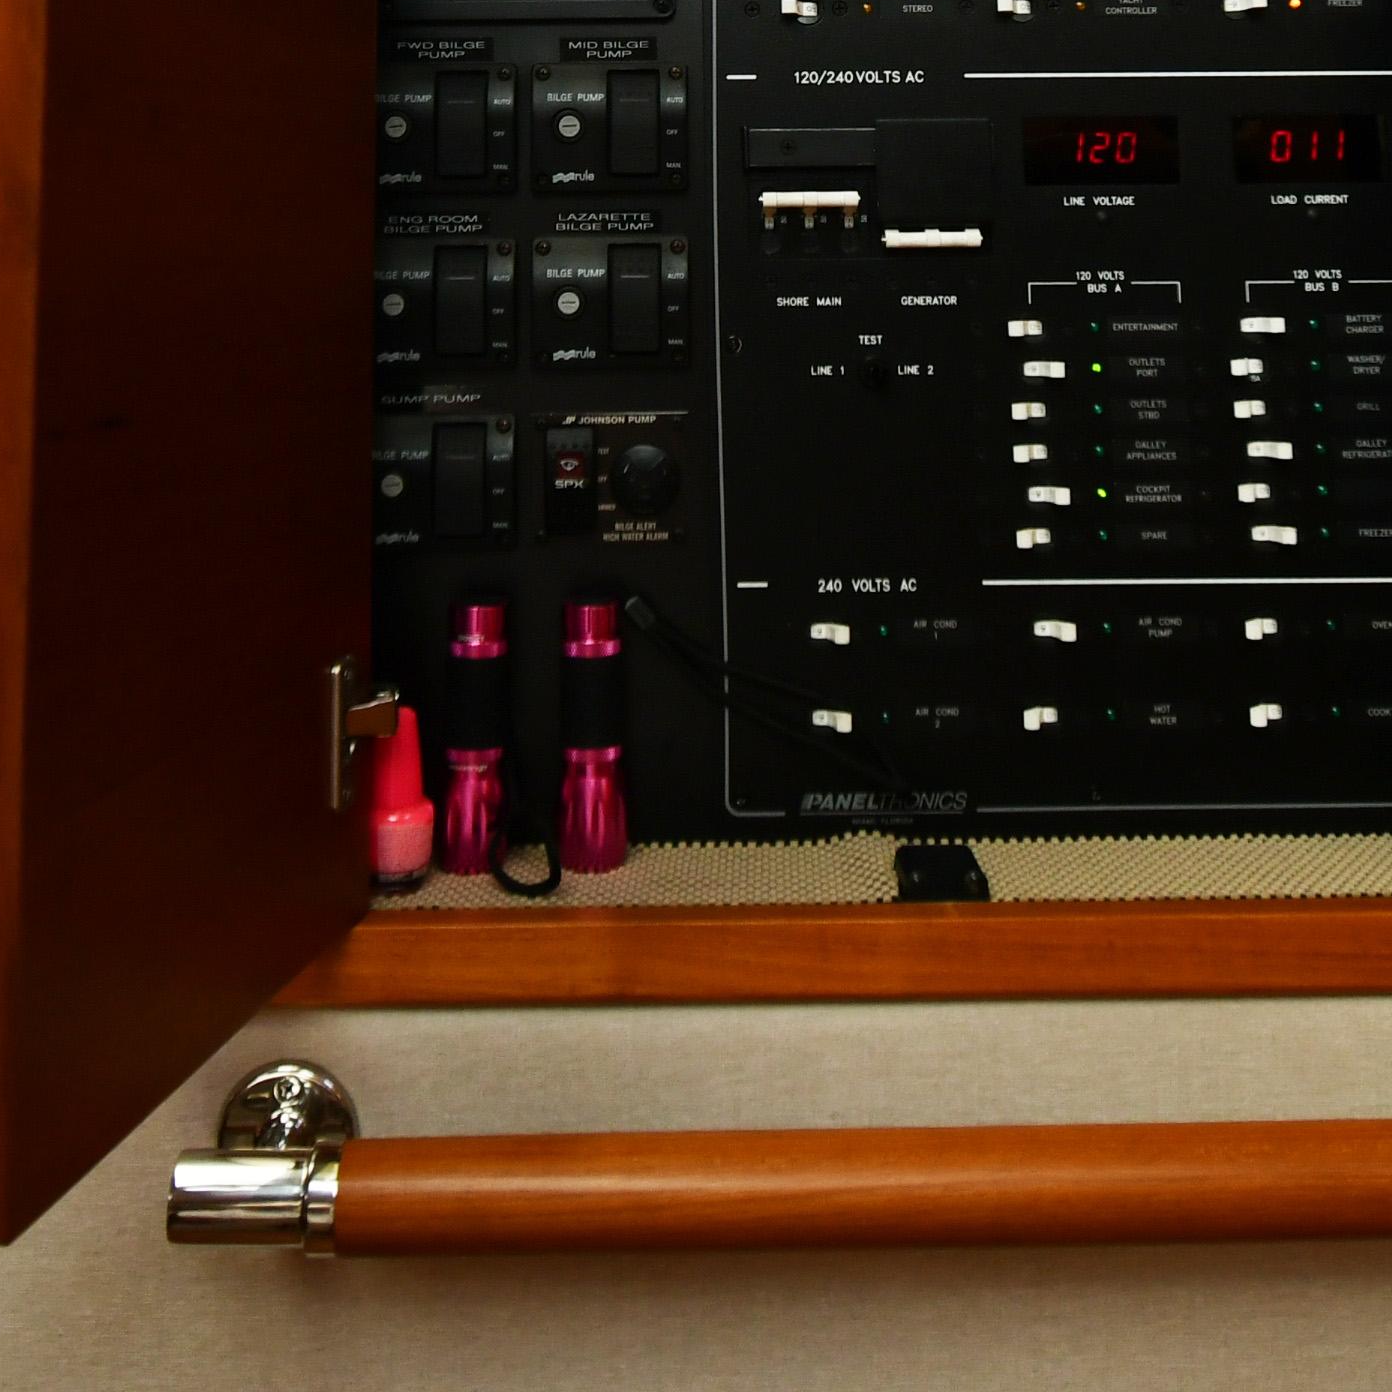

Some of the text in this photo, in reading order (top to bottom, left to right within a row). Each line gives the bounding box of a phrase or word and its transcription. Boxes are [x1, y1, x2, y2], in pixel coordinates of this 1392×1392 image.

[902, 4, 934, 13] STEREO
[1105, 6, 1158, 15] CONTROLLER
[397, 40, 486, 50] FWD BILGE
[568, 40, 649, 50] MID BILGE
[418, 50, 466, 59] PUMP
[586, 50, 632, 59] PUMP
[793, 70, 925, 86] 120/240 VOLTS AC
[404, 94, 433, 103] PUMP
[493, 97, 511, 106] AUTO
[546, 92, 605, 103] BILGE PUMP
[666, 96, 684, 104] AUTO
[492, 129, 505, 138] OFF
[666, 128, 679, 136] OFF
[1074, 130, 1138, 166] 120
[1269, 129, 1346, 164] 011
[666, 161, 681, 169] MAN
[1063, 195, 1136, 207] LINE VOLTAGE
[1270, 194, 1350, 205] LOAD CURRENT
[388, 214, 478, 225] ENG ROOM
[557, 212, 652, 222] LAZARETTE
[383, 224, 483, 234] BILGE PUMP
[555, 221, 655, 232] BILGE PUMP
[402, 271, 431, 280] PUMP
[546, 268, 605, 279] BILGE PUMP
[667, 271, 685, 280] AUTO
[1075, 270, 1125, 281] 120 VOLTS
[1292, 269, 1342, 280] 120 VOLTS
[1087, 283, 1122, 294] BUS A
[1304, 282, 1340, 292] BUS B
[776, 296, 843, 307] SHORE MAIN
[900, 295, 958, 306] GENERATOR
[667, 304, 680, 313] OFF
[1345, 314, 1383, 323] BATTERY
[1112, 322, 1179, 331] ENTERTAINMENT
[1345, 325, 1384, 334] CHARGER
[858, 334, 883, 345] TEST
[1128, 358, 1166, 367] OUTLETS
[810, 365, 833, 376] LINE
[897, 364, 935, 376] LINE 2
[1136, 369, 1159, 378] PORT
[432, 394, 481, 404] PUMP
[1129, 399, 1167, 409] OUTLETS
[578, 415, 657, 425] JOHNSON PUMP
[1135, 440, 1168, 450] GALLEY
[1355, 439, 1388, 448] GALLEY
[1126, 452, 1177, 461] APPLIANCES
[554, 478, 585, 490] SPX
[1136, 485, 1171, 494] COCKPIT
[1125, 494, 1183, 503] REFRIGERATOR
[1140, 531, 1168, 541] SPARE
[817, 577, 918, 594] 240 VOLTS AC
[913, 619, 958, 629] AIR COND
[1138, 617, 1183, 626] AIR COND
[1148, 628, 1173, 638] PUMP
[915, 707, 960, 717] AIR COND
[1149, 716, 1177, 726] WATER
